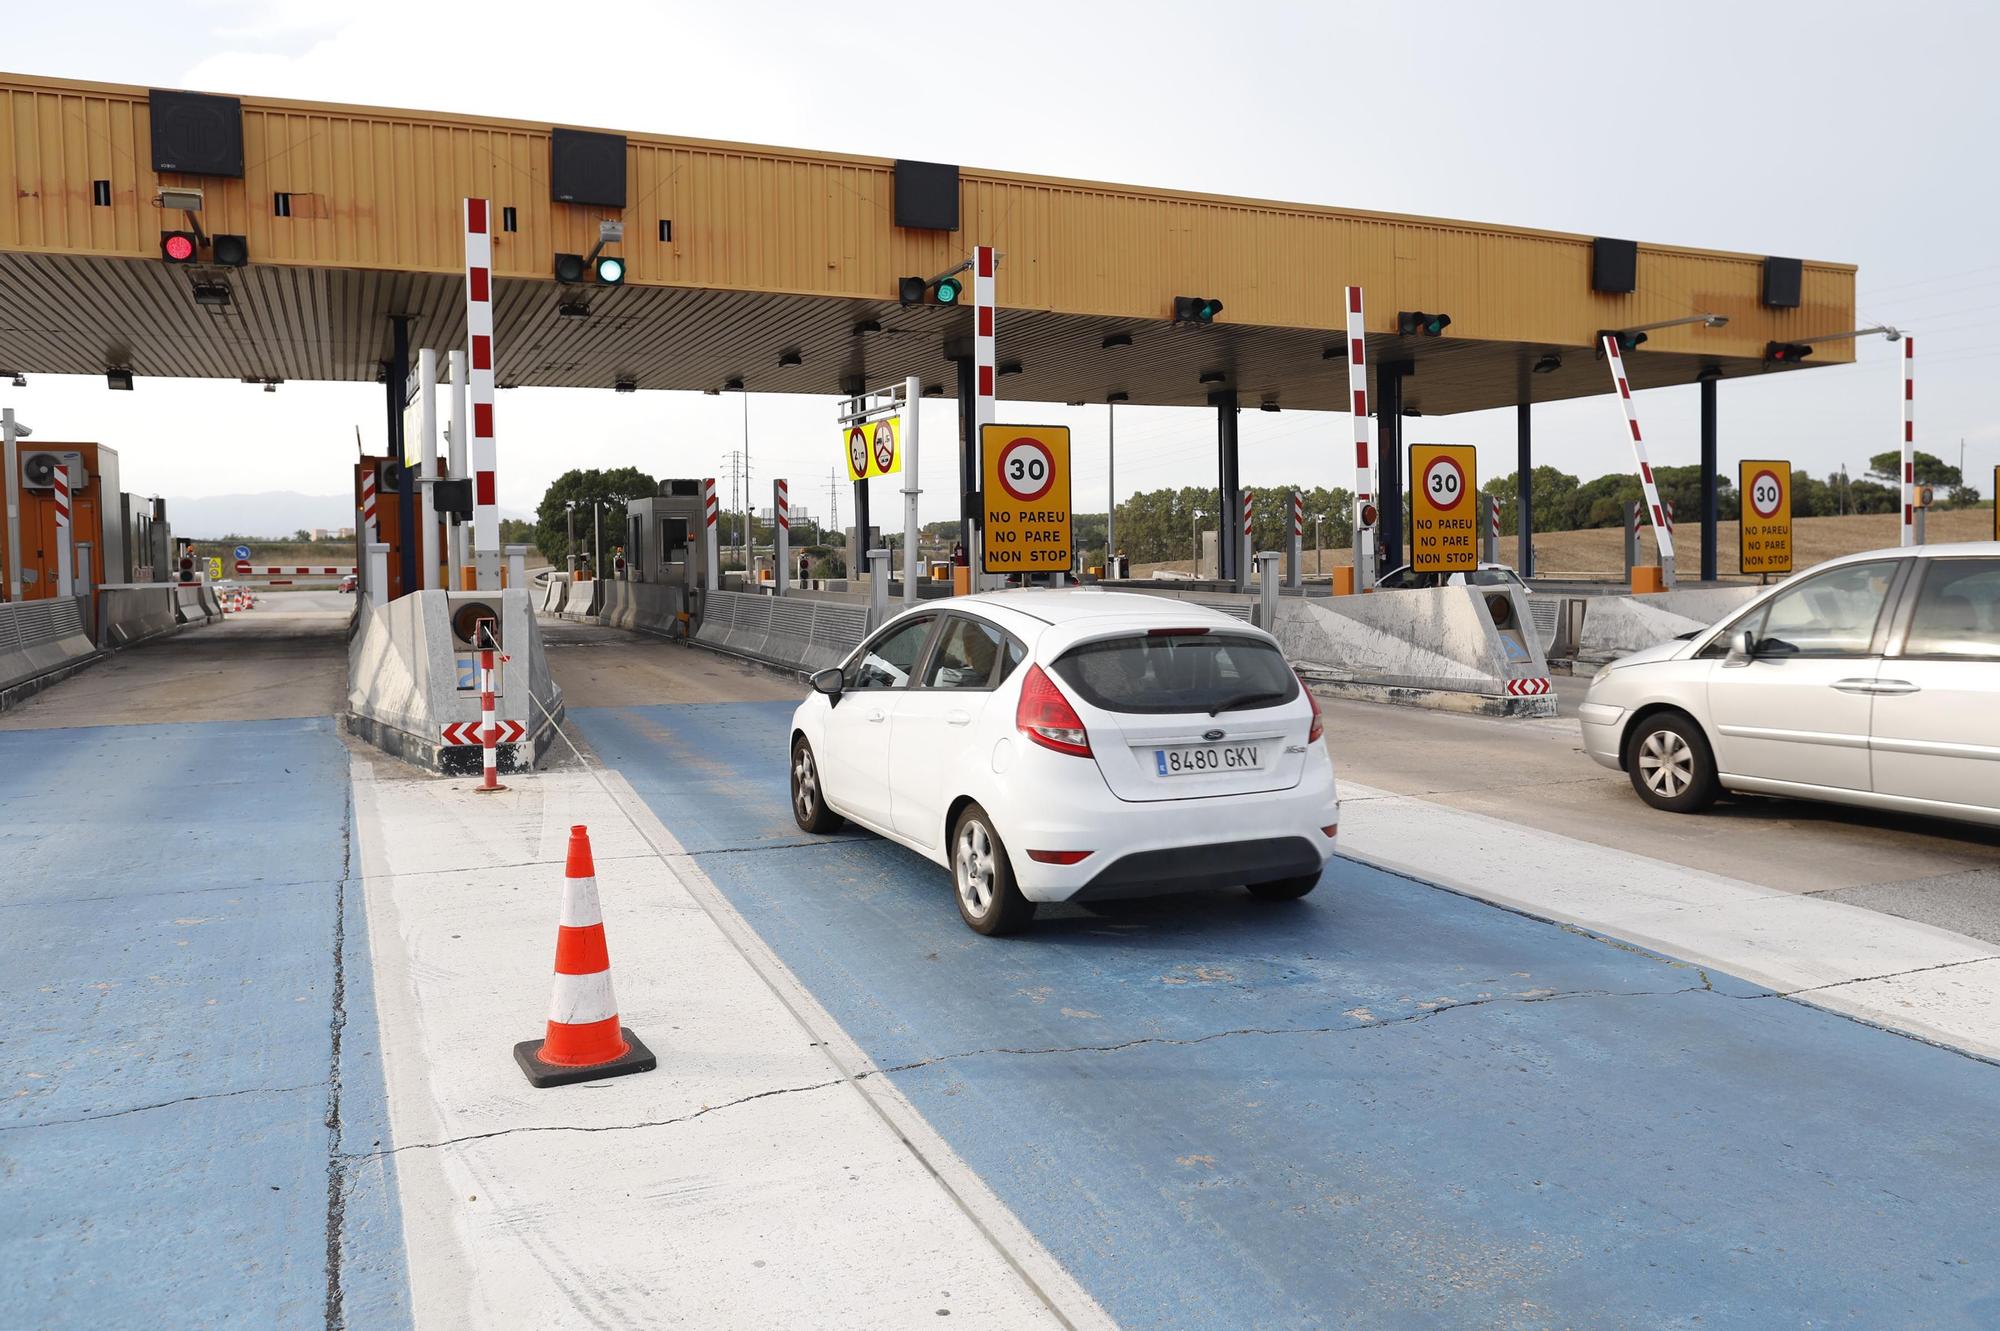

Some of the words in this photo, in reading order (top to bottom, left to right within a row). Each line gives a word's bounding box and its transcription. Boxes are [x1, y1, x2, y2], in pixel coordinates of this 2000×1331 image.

[1010, 459, 1045, 480] 30
[1431, 474, 1458, 493] 30
[1756, 486, 1776, 502] 30
[989, 511, 1011, 523] NO
[1019, 511, 1065, 523] PAREU
[1416, 519, 1433, 529] NO
[1438, 519, 1473, 529] PAREU
[1745, 526, 1758, 535] NO
[1761, 526, 1789, 535] PAREU
[995, 531, 1017, 542] NO
[1025, 531, 1061, 542] PARE
[1421, 536, 1437, 546] NO
[1442, 536, 1469, 546] PARE
[1748, 541, 1761, 550] NO
[1765, 541, 1786, 550] PARE
[989, 551, 1022, 562] NON
[1030, 550, 1067, 561] STOP
[1416, 553, 1440, 564] NON
[1446, 553, 1474, 563] STOP
[1744, 556, 1764, 566] NON
[1767, 555, 1790, 565] STOP
[1169, 749, 1218, 771] 8480
[1224, 747, 1258, 767] GKV
